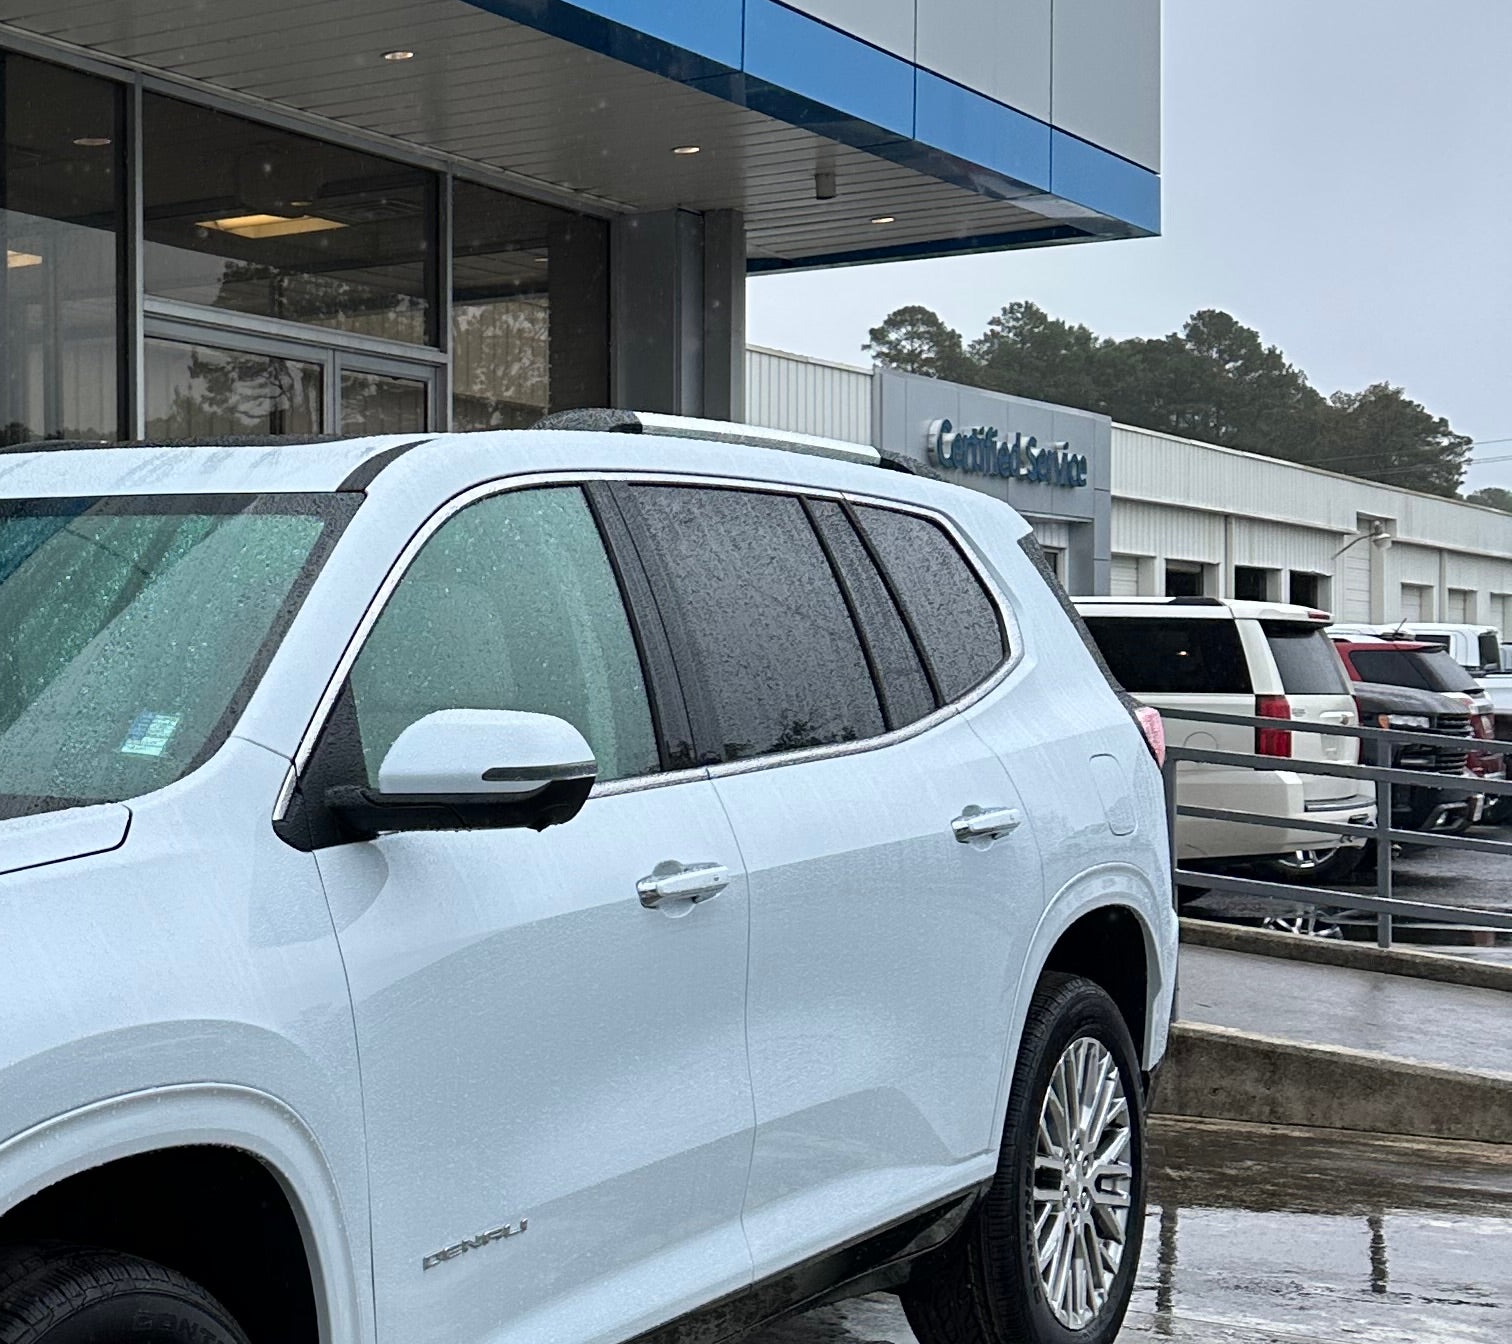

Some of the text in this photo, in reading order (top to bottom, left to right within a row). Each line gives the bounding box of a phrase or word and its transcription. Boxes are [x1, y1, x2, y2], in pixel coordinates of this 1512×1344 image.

[931, 419, 1087, 487] Certified Service
[422, 1217, 528, 1271] DENALI
